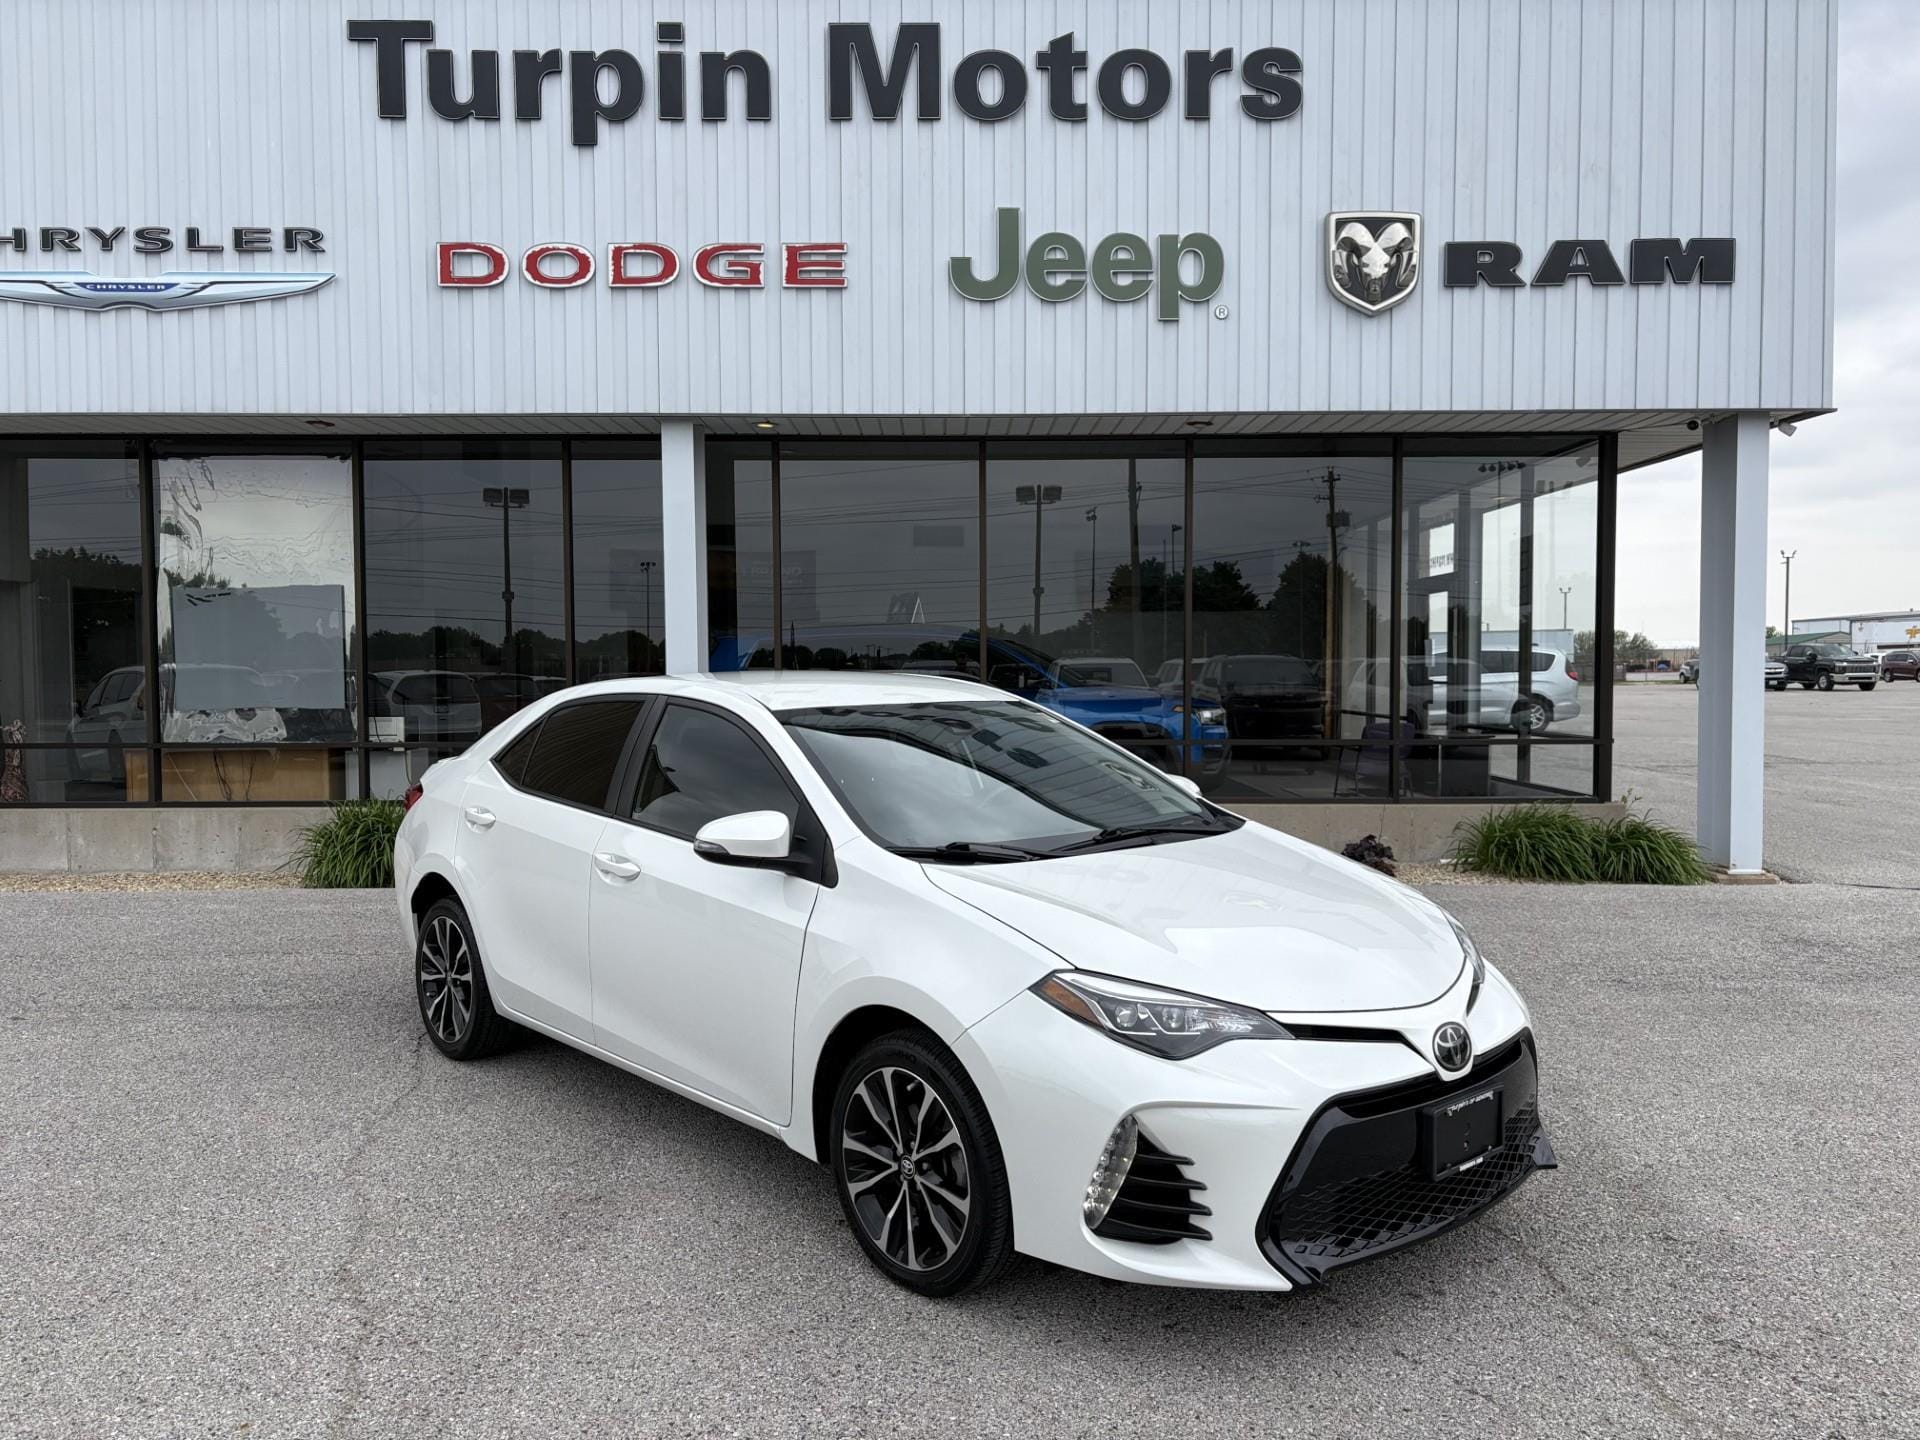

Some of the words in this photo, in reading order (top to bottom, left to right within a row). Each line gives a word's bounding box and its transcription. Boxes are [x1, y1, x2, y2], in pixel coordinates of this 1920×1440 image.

[347, 20, 771, 146] Turpin
[827, 22, 1303, 121] Motors
[0, 226, 326, 253] HRYSLER
[436, 242, 848, 288] DODGE
[949, 207, 1225, 321] Jeep
[1444, 237, 1737, 288] RAM
